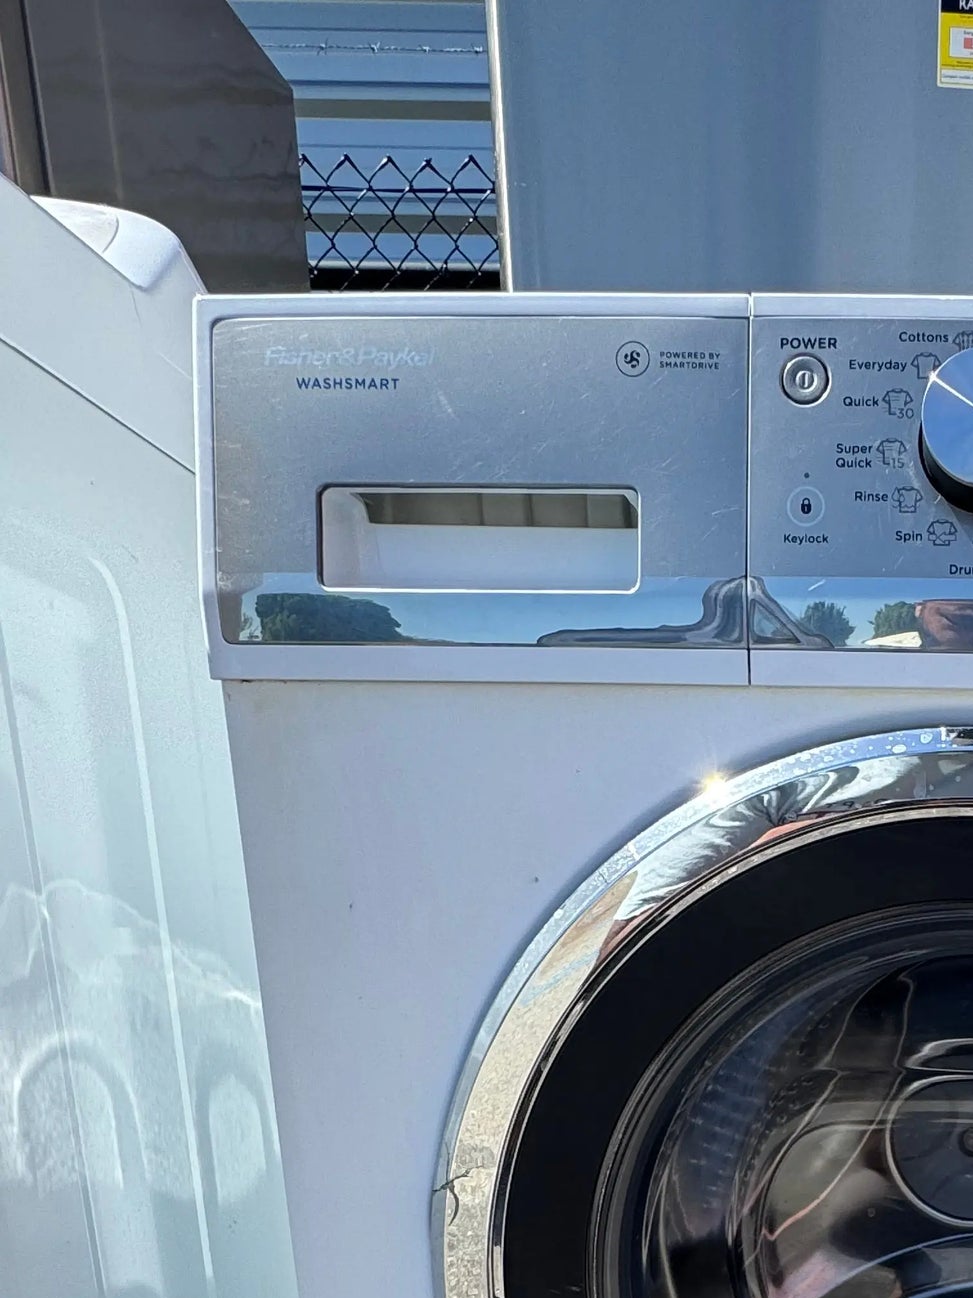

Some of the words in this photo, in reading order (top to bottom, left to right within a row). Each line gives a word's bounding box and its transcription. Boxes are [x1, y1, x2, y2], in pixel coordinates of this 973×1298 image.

[780, 337, 837, 350] POWER
[899, 331, 949, 344] Cottons
[660, 351, 706, 359] POWERED
[709, 352, 721, 360] BY
[659, 361, 720, 370] SMARTDRIVE
[849, 359, 907, 372] Everyday
[296, 377, 400, 390] WASHSMART
[843, 396, 880, 407] Quick
[897, 408, 915, 419] 30
[836, 442, 873, 455] Super
[835, 457, 872, 469] Quick
[891, 457, 905, 469] 15
[854, 491, 889, 502] Rinse
[783, 533, 829, 545] Keylock
[895, 530, 923, 543] Spin
